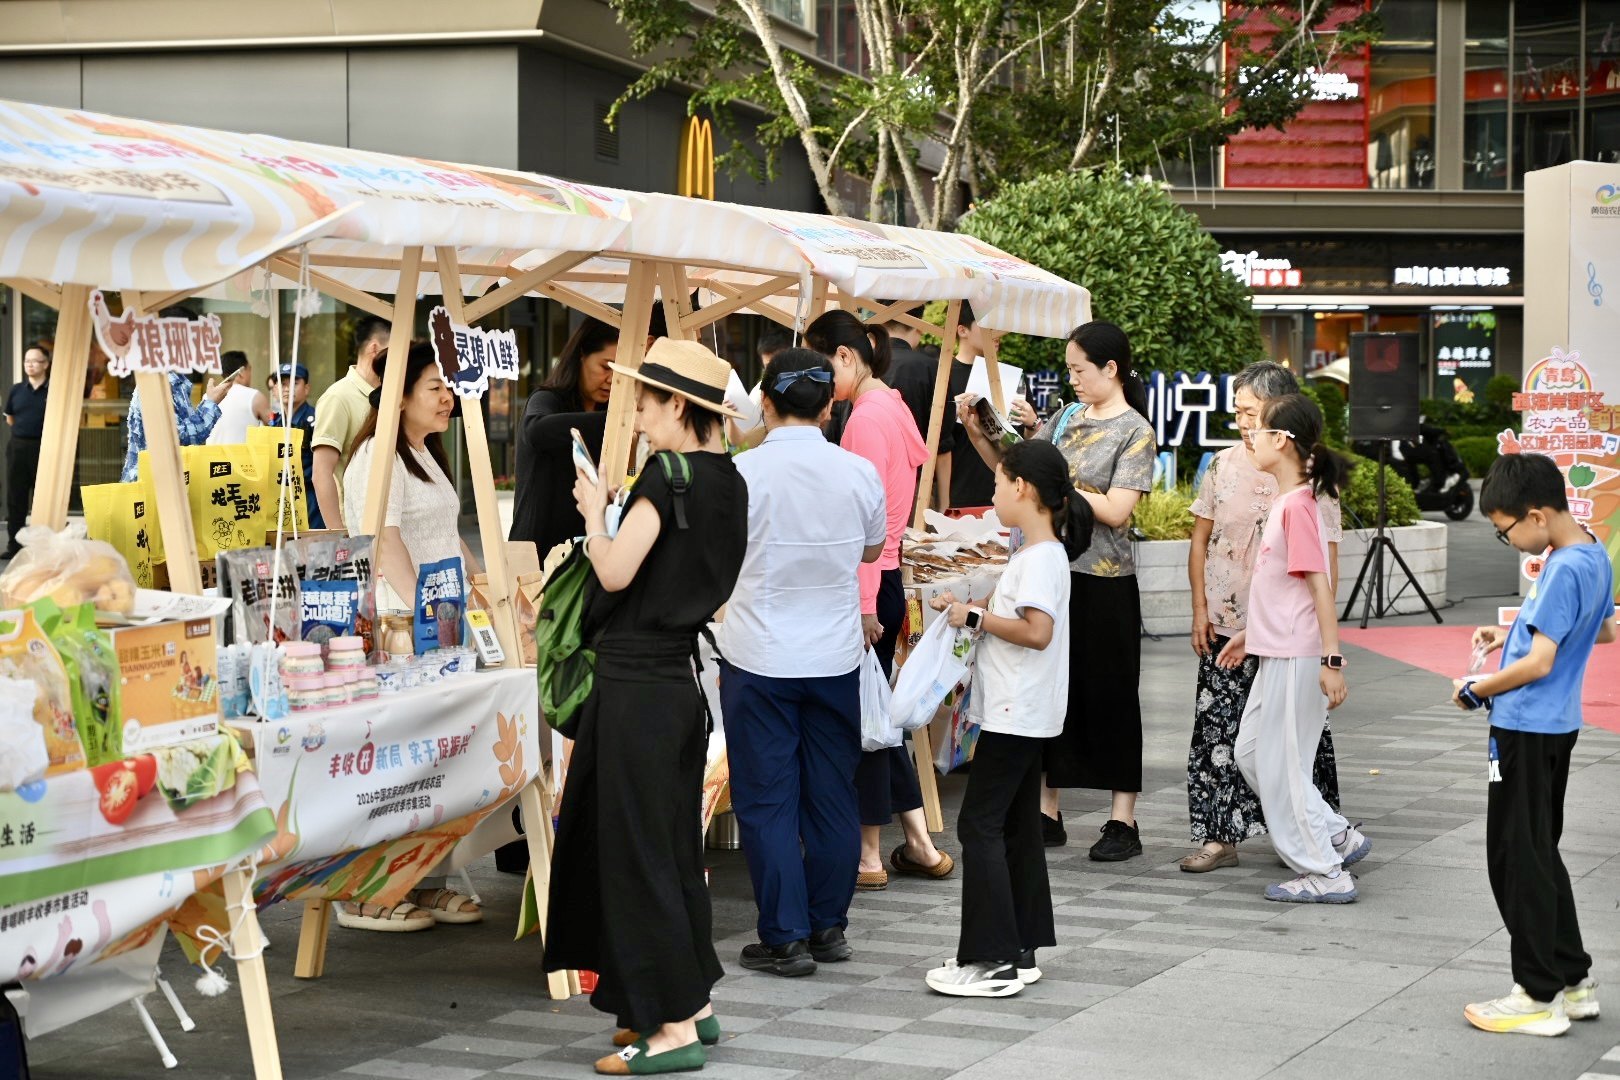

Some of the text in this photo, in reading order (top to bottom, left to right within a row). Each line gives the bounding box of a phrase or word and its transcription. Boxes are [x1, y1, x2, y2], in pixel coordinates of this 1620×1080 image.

[1150, 373, 1241, 446] 悦
[1512, 392, 1604, 411] 西海岸新区
[1528, 417, 1586, 429] 农产品
[1521, 434, 1604, 449] 区域公用品牌
[1, 822, 35, 847] 生活
